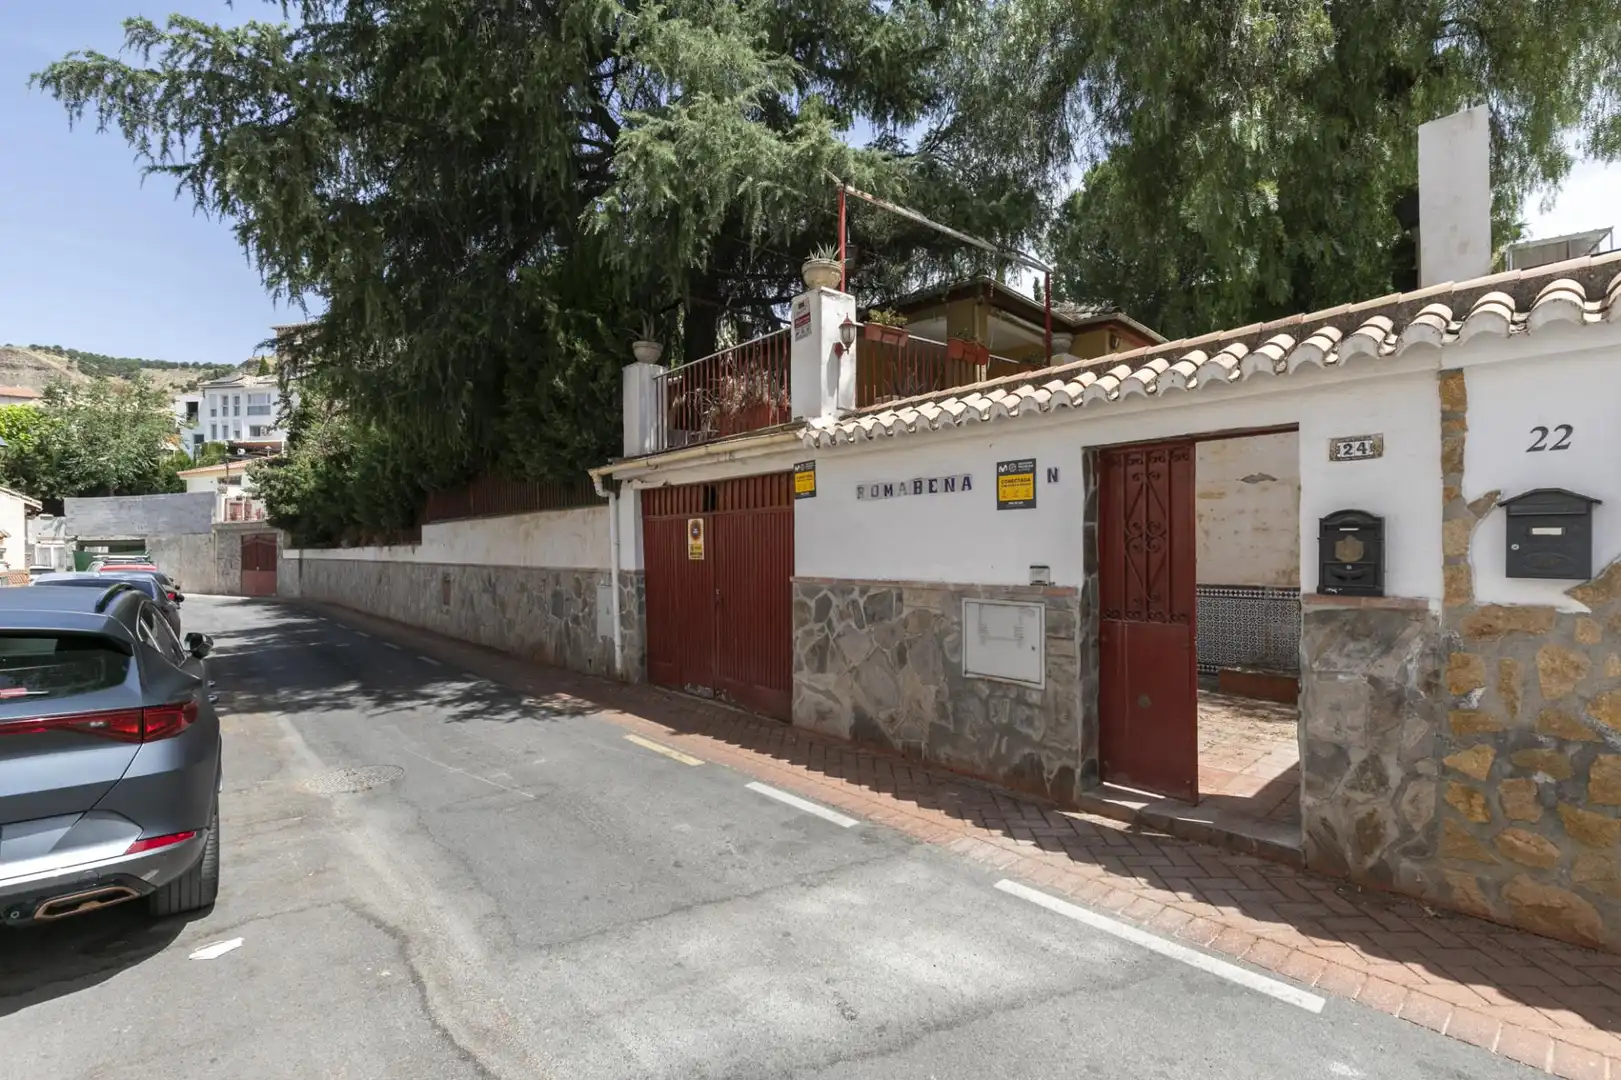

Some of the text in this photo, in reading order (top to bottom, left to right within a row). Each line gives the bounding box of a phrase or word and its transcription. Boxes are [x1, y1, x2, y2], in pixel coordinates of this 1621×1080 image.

[1525, 423, 1575, 453] 22
[1342, 442, 1370, 456] 24
[1047, 466, 1059, 483] N
